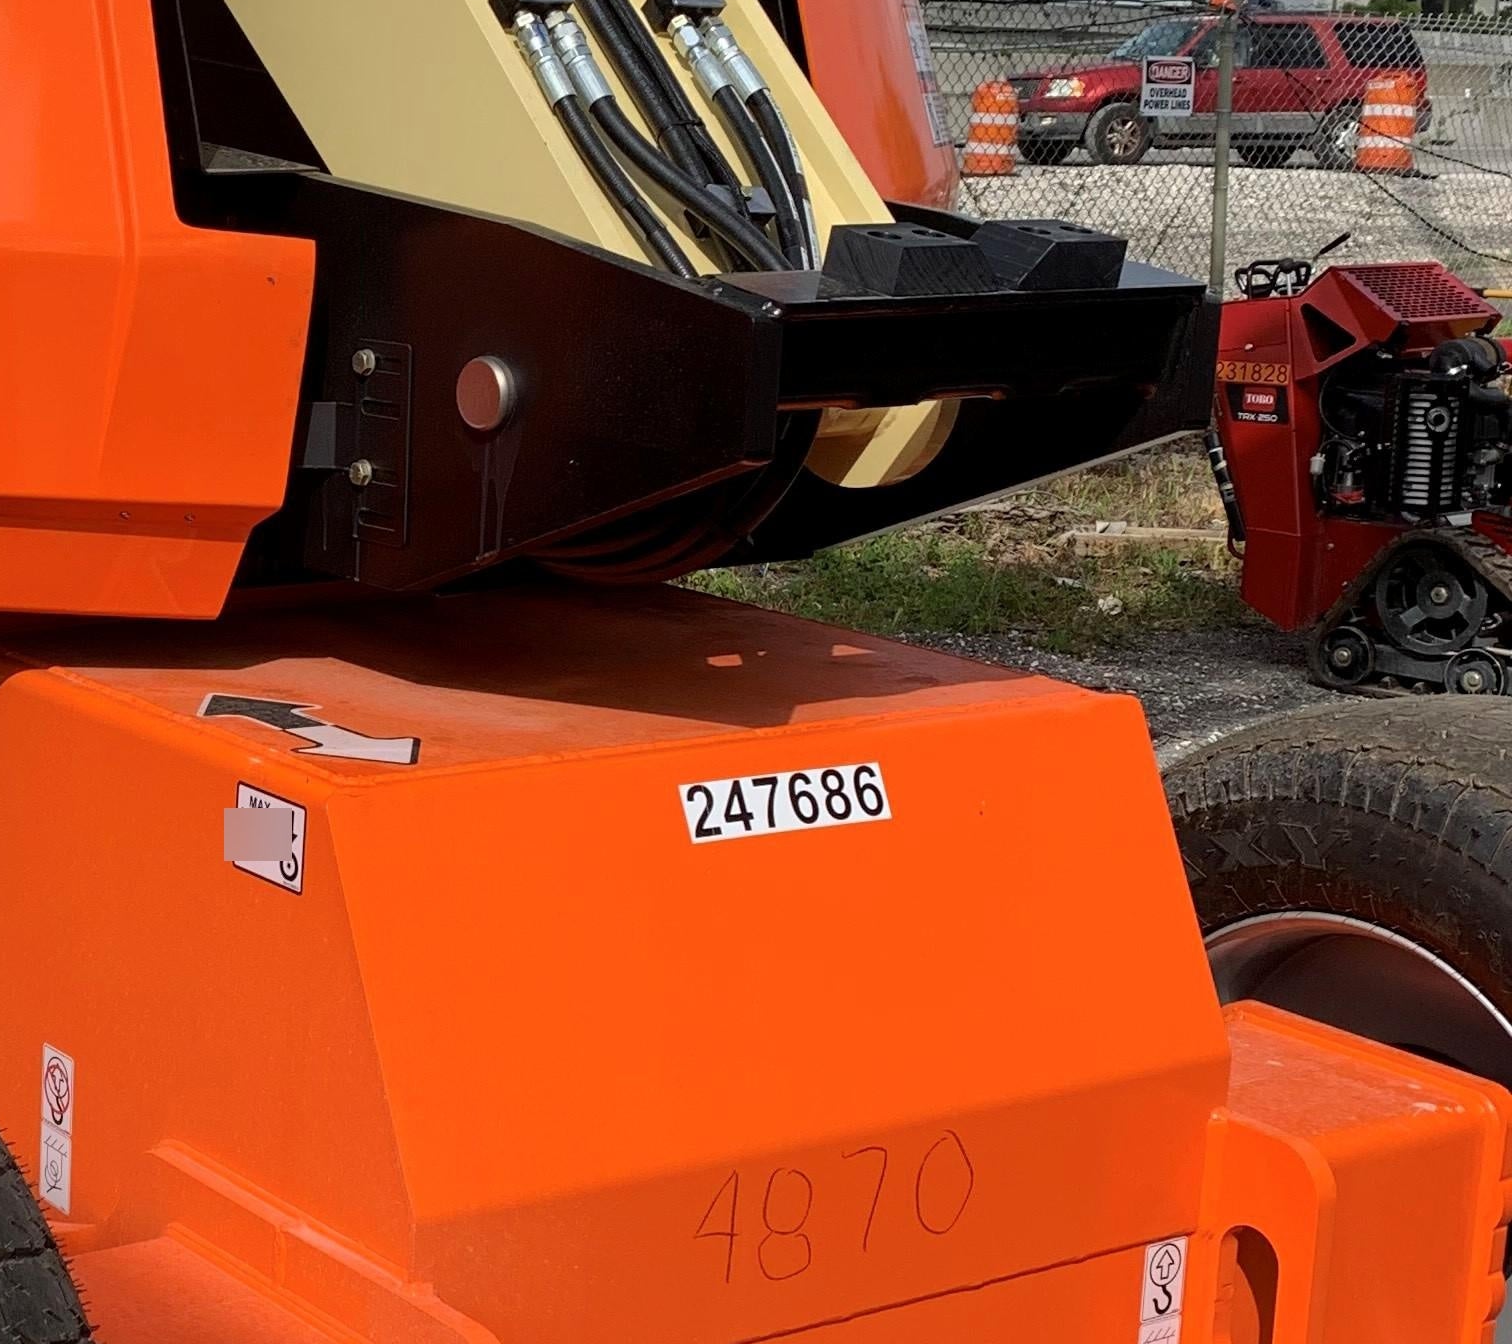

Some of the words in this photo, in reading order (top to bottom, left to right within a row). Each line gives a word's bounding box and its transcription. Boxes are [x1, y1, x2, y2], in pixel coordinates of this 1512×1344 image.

[1150, 65, 1189, 78] DANGER
[1149, 87, 1187, 98] OVERHEAD
[1143, 99, 1170, 110] POWER
[1171, 99, 1191, 110] LINES
[1216, 361, 1287, 383] 231828
[1245, 393, 1274, 405] TORO
[687, 765, 884, 838] 247686
[693, 1129, 974, 1284] 4870
